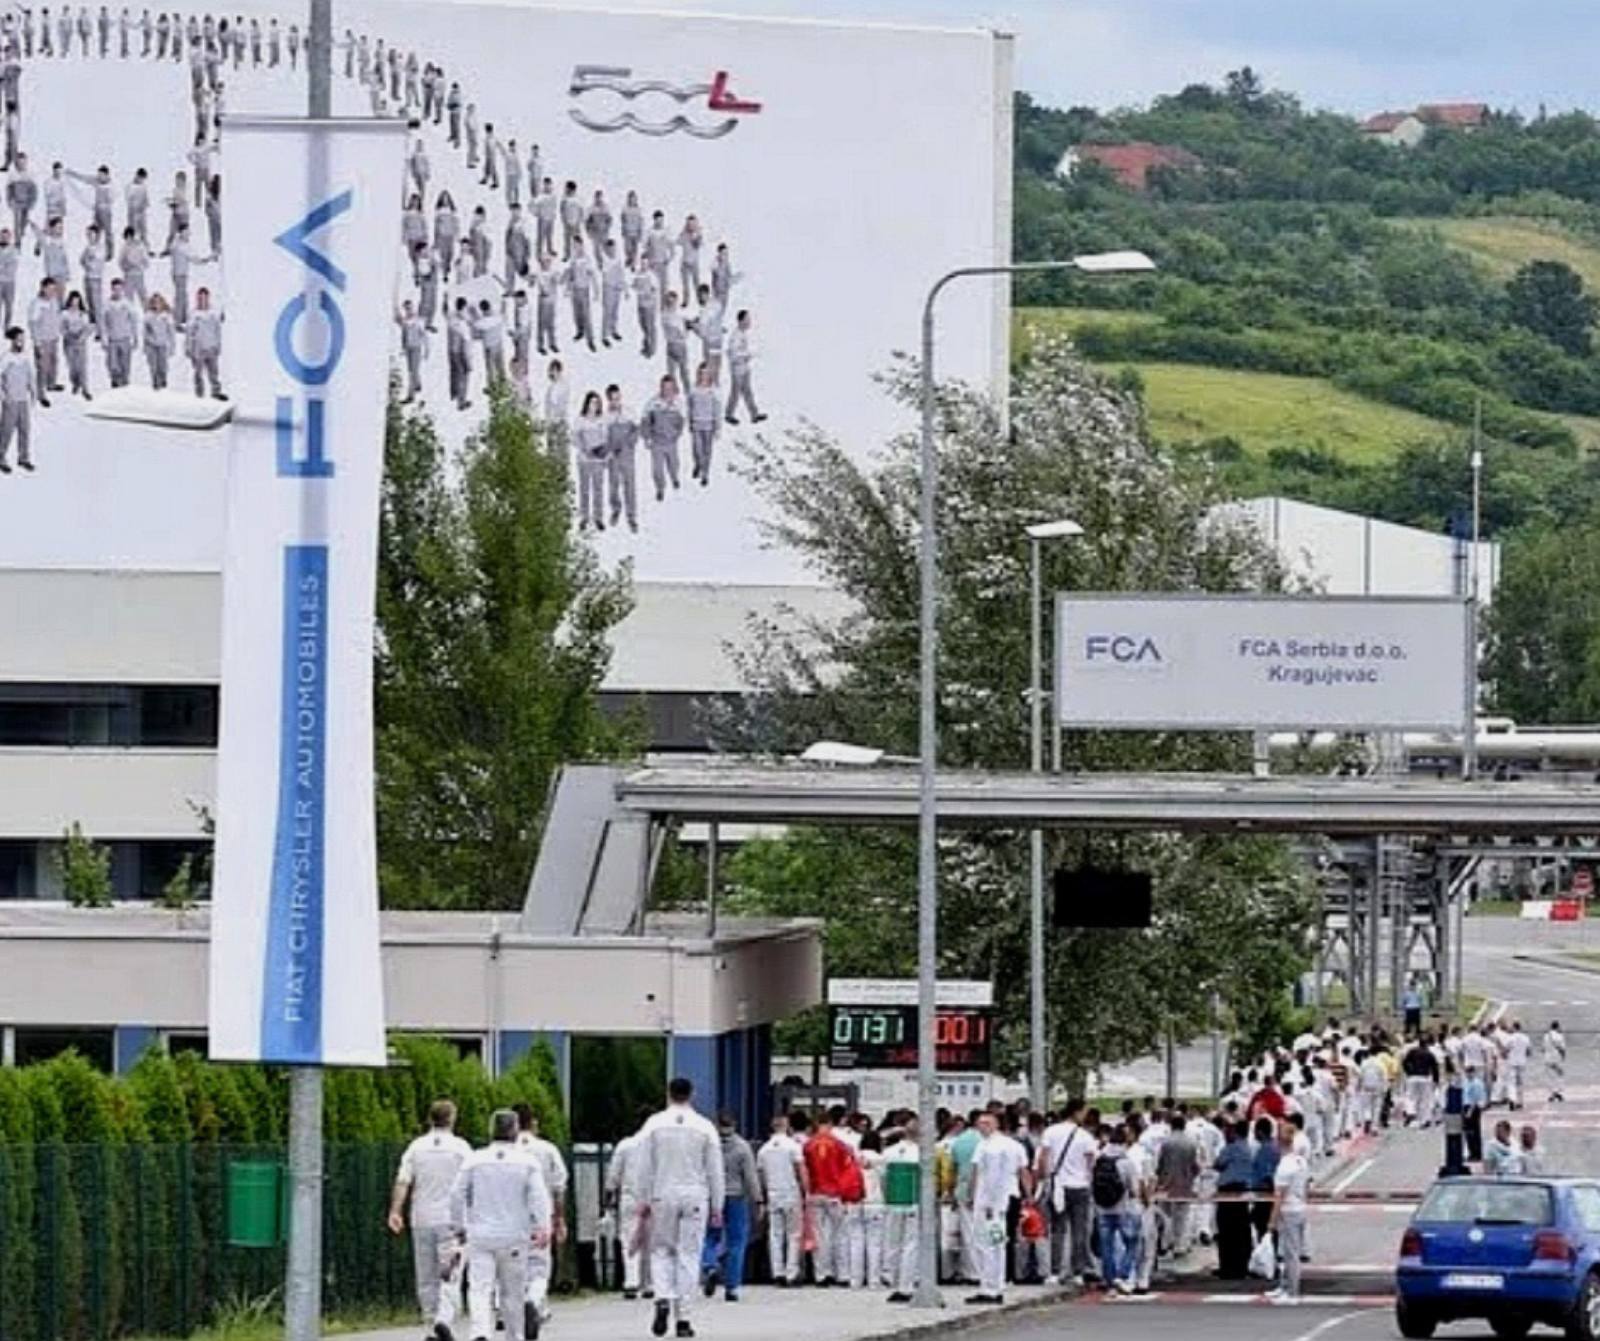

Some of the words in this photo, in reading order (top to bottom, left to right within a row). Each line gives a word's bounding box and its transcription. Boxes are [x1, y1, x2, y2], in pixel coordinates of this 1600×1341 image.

[272, 188, 354, 479] FCA
[297, 574, 320, 790] AUTOMOBILES
[1085, 635, 1163, 663] FCA
[1239, 639, 1282, 658] FCA
[1286, 639, 1349, 659] Serbia
[1353, 642, 1408, 661] d.o.o.
[1267, 664, 1379, 686] Kragujevac
[288, 799, 314, 951] CHRYSLER
[284, 957, 305, 1023] FIAT
